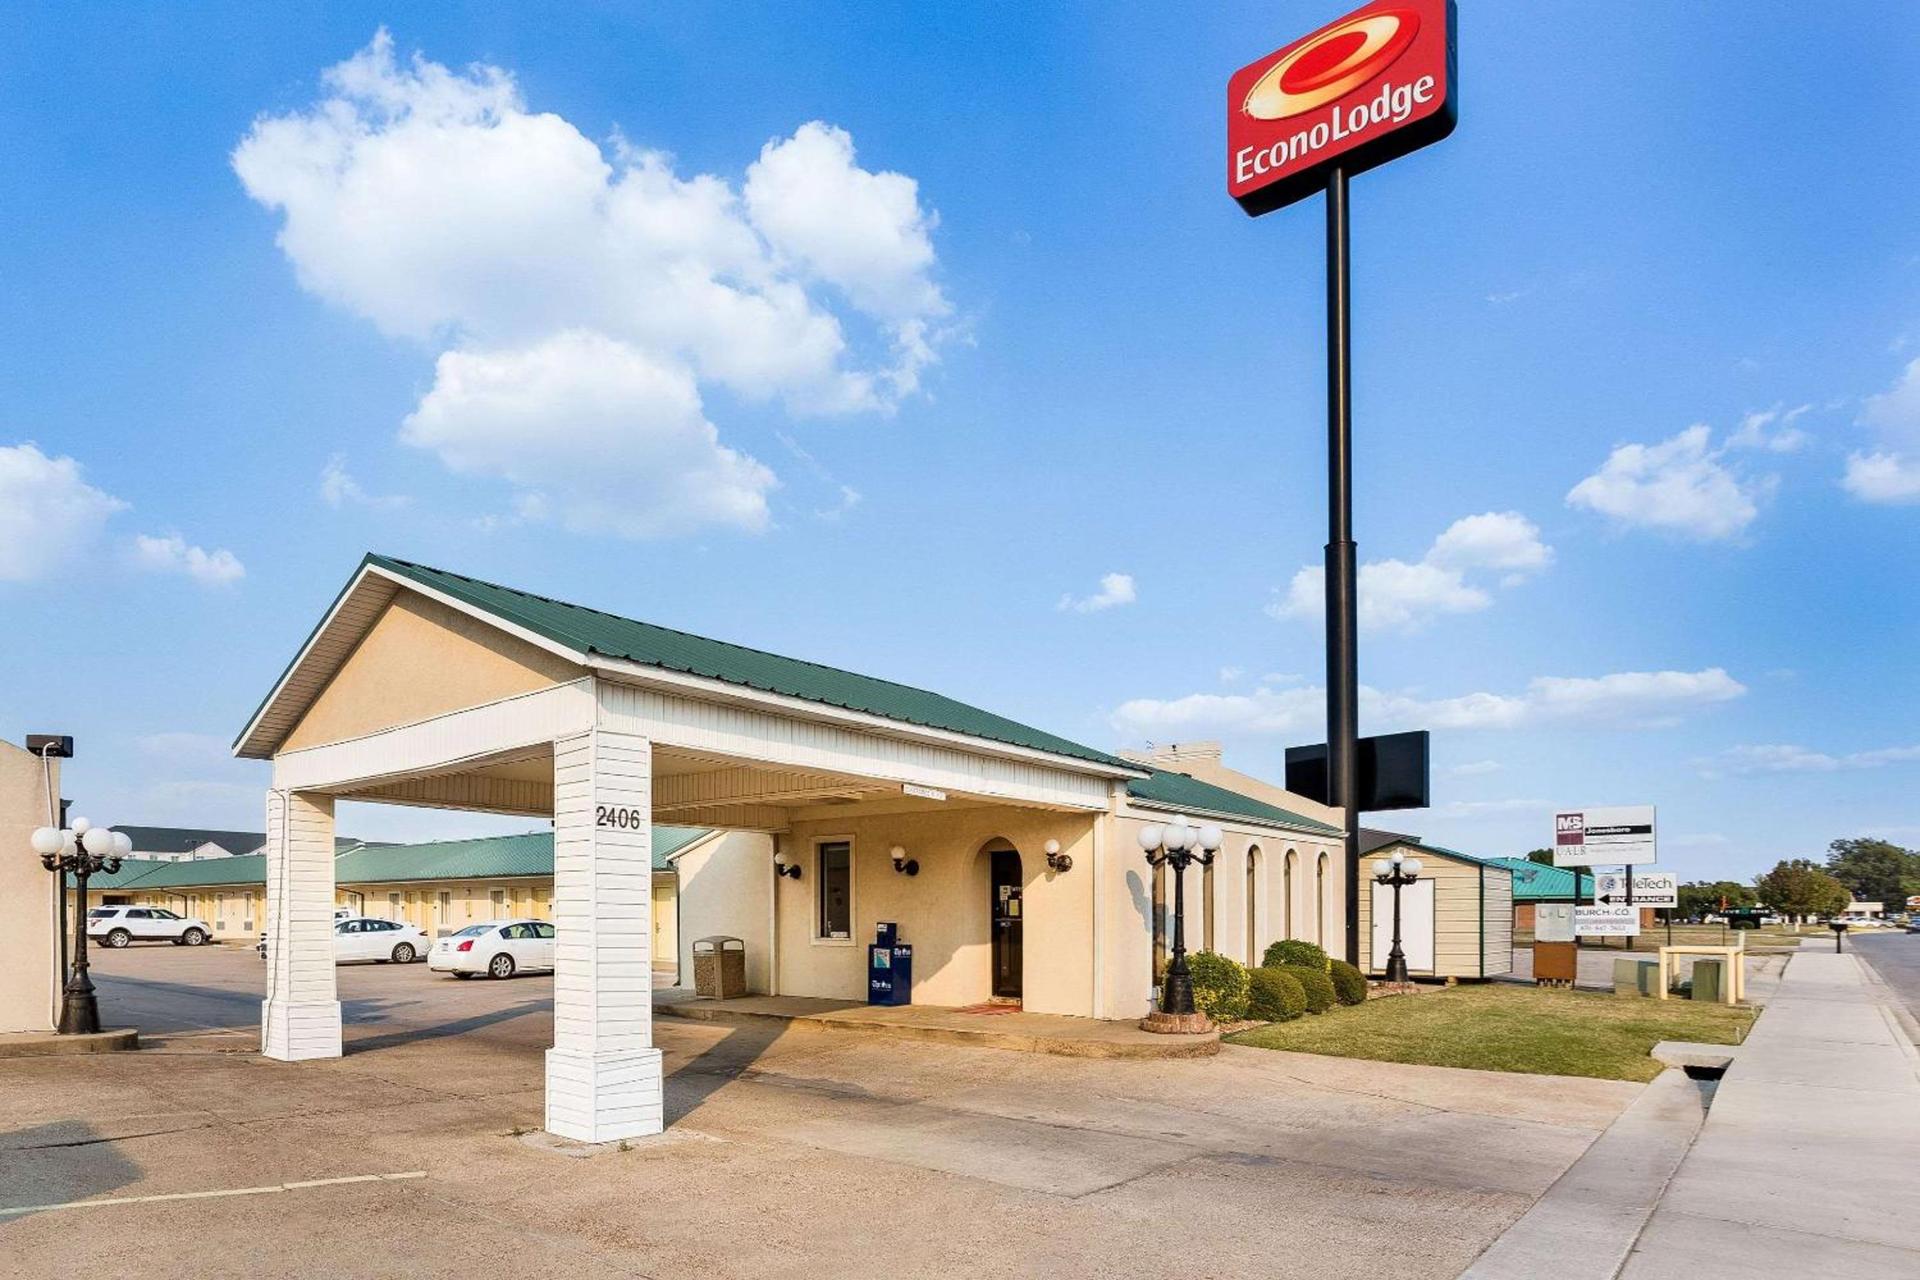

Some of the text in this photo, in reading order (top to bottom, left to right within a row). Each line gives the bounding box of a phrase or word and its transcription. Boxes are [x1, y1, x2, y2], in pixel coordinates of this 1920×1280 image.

[1236, 75, 1435, 184] EconoLodge
[596, 806, 640, 829] 2406
[1620, 877, 1672, 889] TleTech
[1610, 895, 1672, 903] ENRANCE
